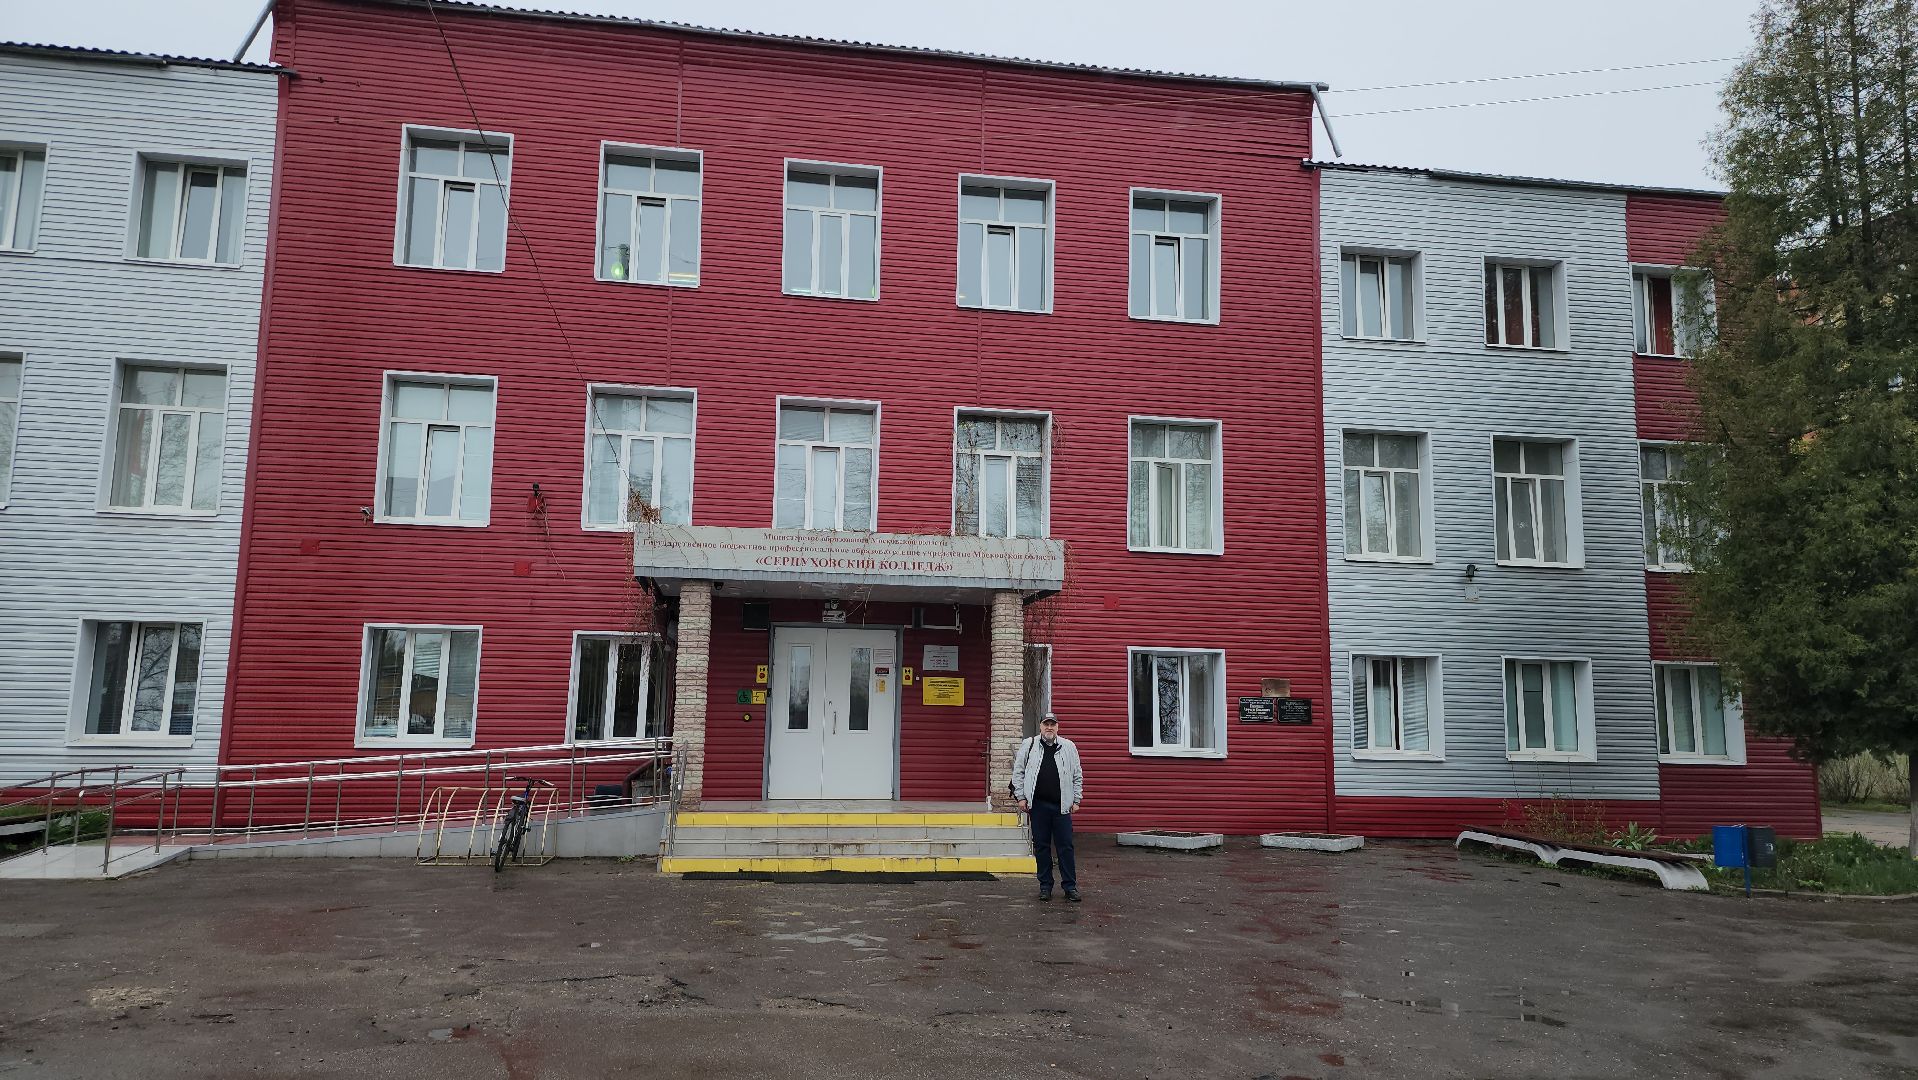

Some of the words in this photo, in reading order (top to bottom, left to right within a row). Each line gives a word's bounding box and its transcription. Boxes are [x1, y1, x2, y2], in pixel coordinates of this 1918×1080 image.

[643, 538, 716, 549] Государственное
[720, 541, 766, 551] бюджетное
[973, 550, 1022, 560] Московской
[755, 555, 875, 570] «СЕРПУХОВСКИЙ
[880, 559, 953, 573] КОЛЛЕДЖ»
